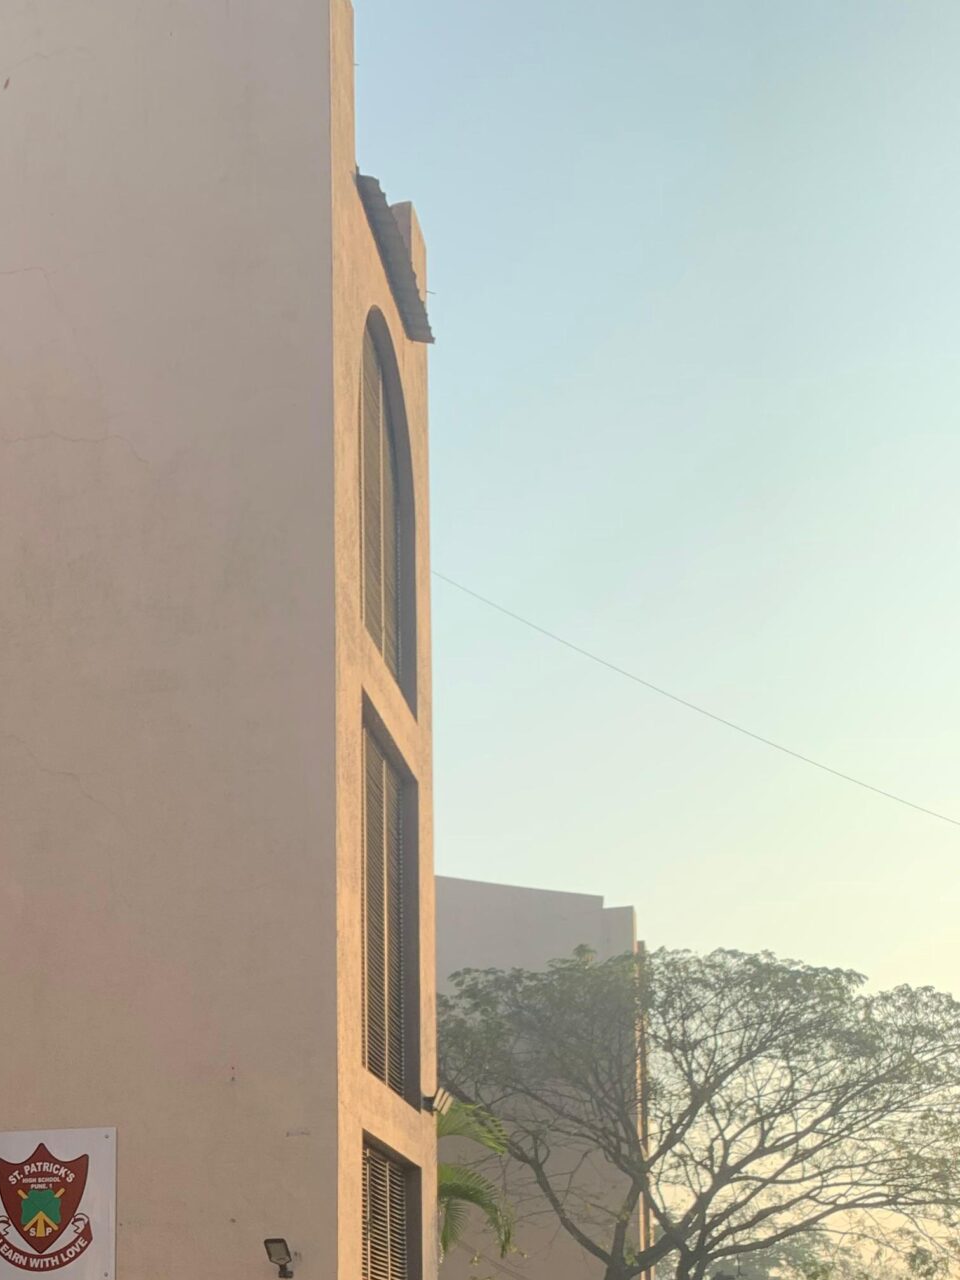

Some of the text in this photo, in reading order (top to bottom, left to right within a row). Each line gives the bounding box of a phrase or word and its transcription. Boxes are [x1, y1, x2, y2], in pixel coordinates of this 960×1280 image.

[8, 1162, 76, 1185] ST. PATRICK'S
[29, 1227, 53, 1237] S P
[29, 1257, 60, 1269] WITH
[60, 1236, 88, 1263] LOVE
